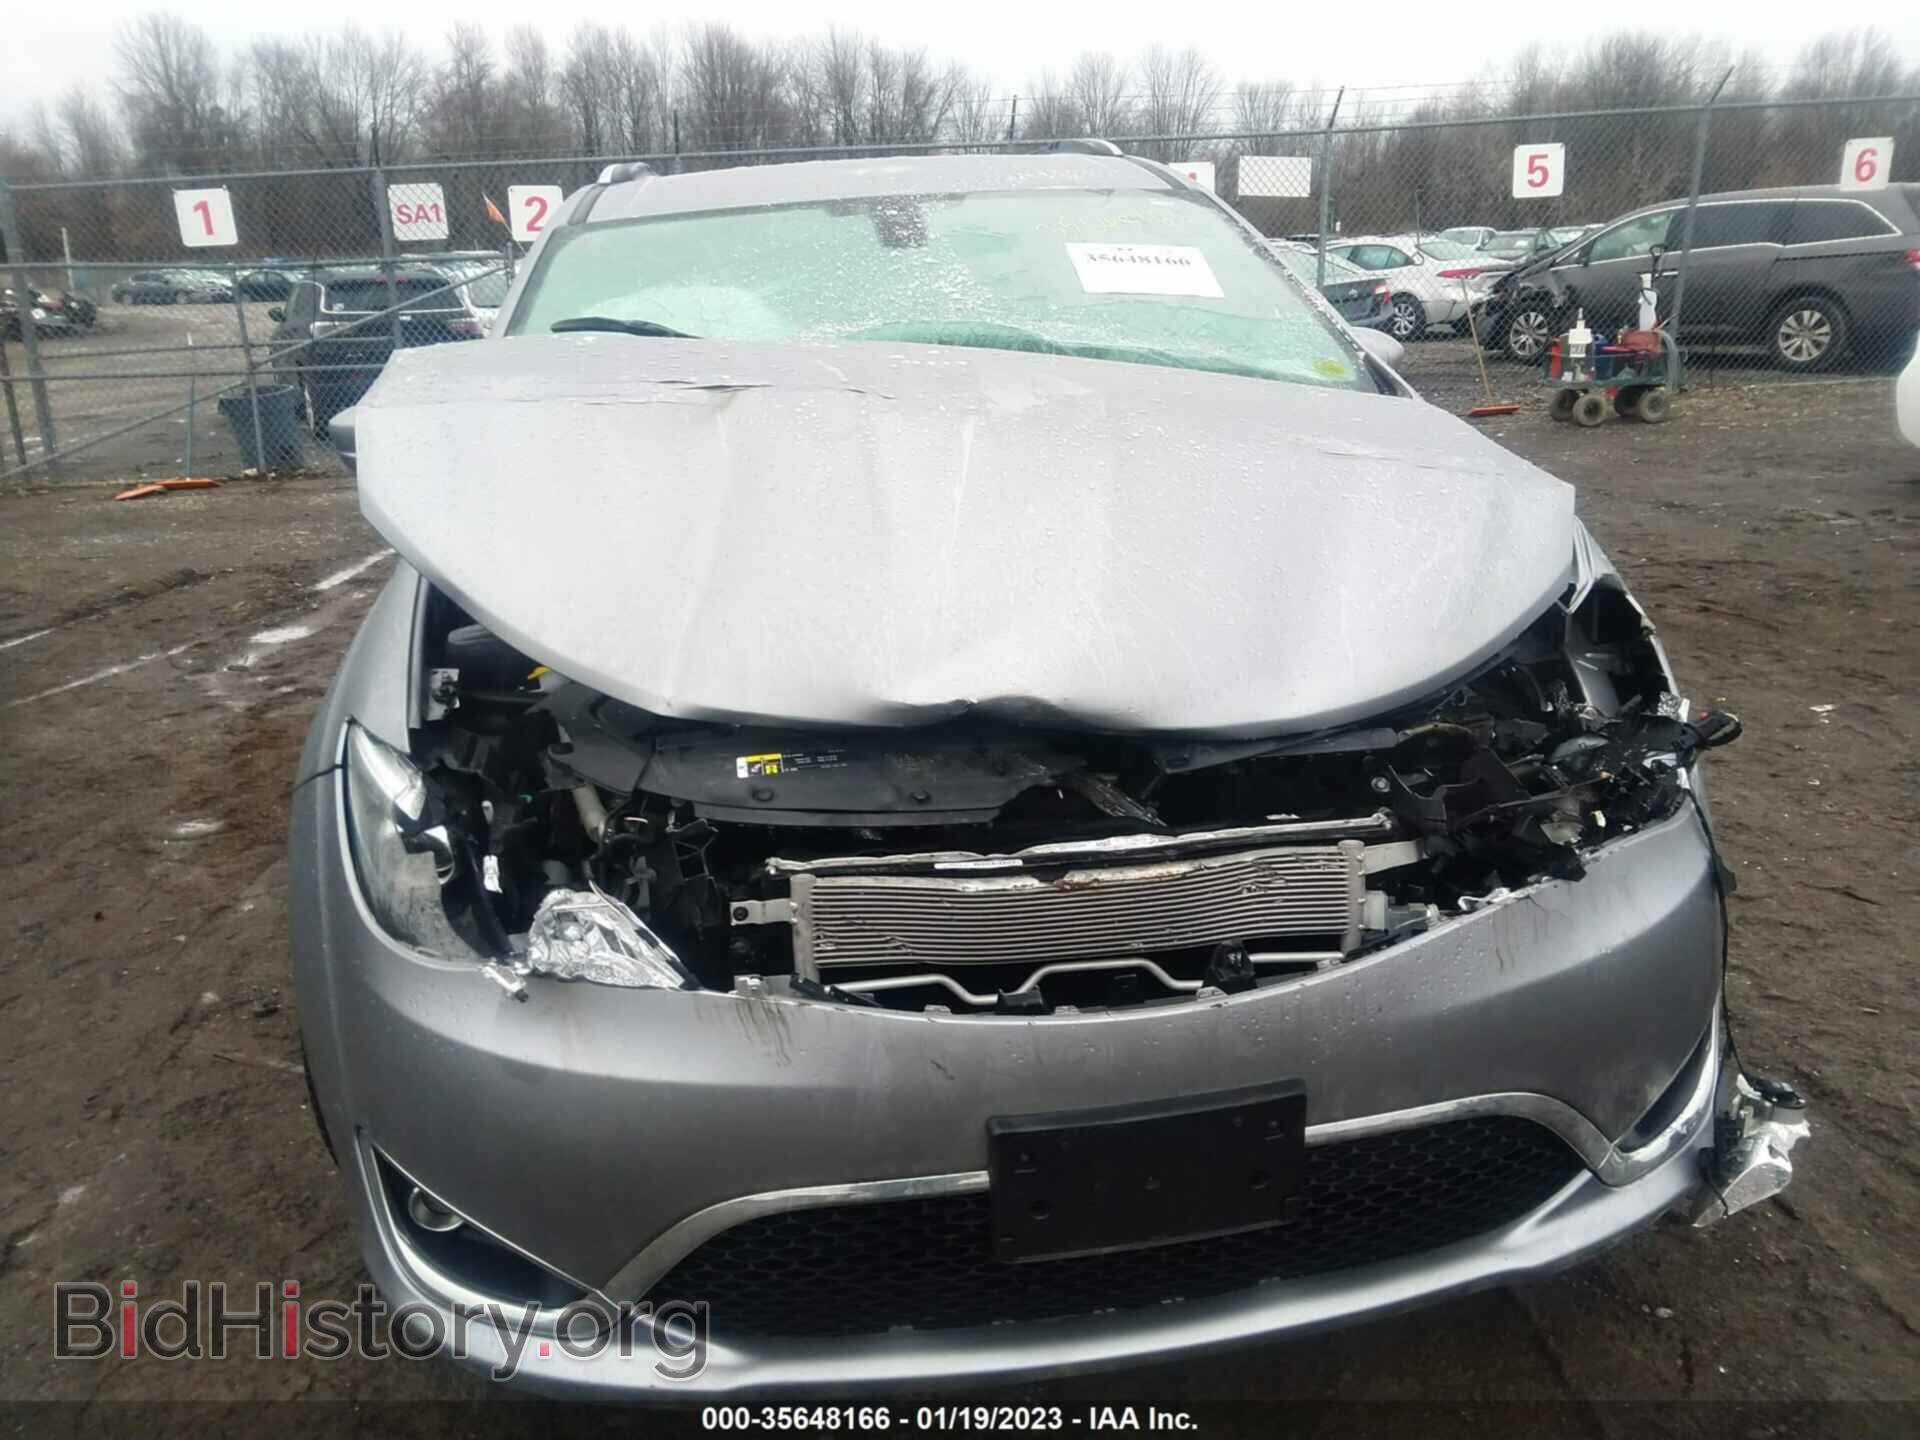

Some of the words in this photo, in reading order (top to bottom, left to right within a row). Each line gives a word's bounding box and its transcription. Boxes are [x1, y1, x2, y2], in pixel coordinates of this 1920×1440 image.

[1527, 154, 1550, 188] 5
[1855, 147, 1878, 183] 6
[193, 200, 215, 236] 1
[396, 203, 441, 225] SA1
[524, 196, 549, 233] 2
